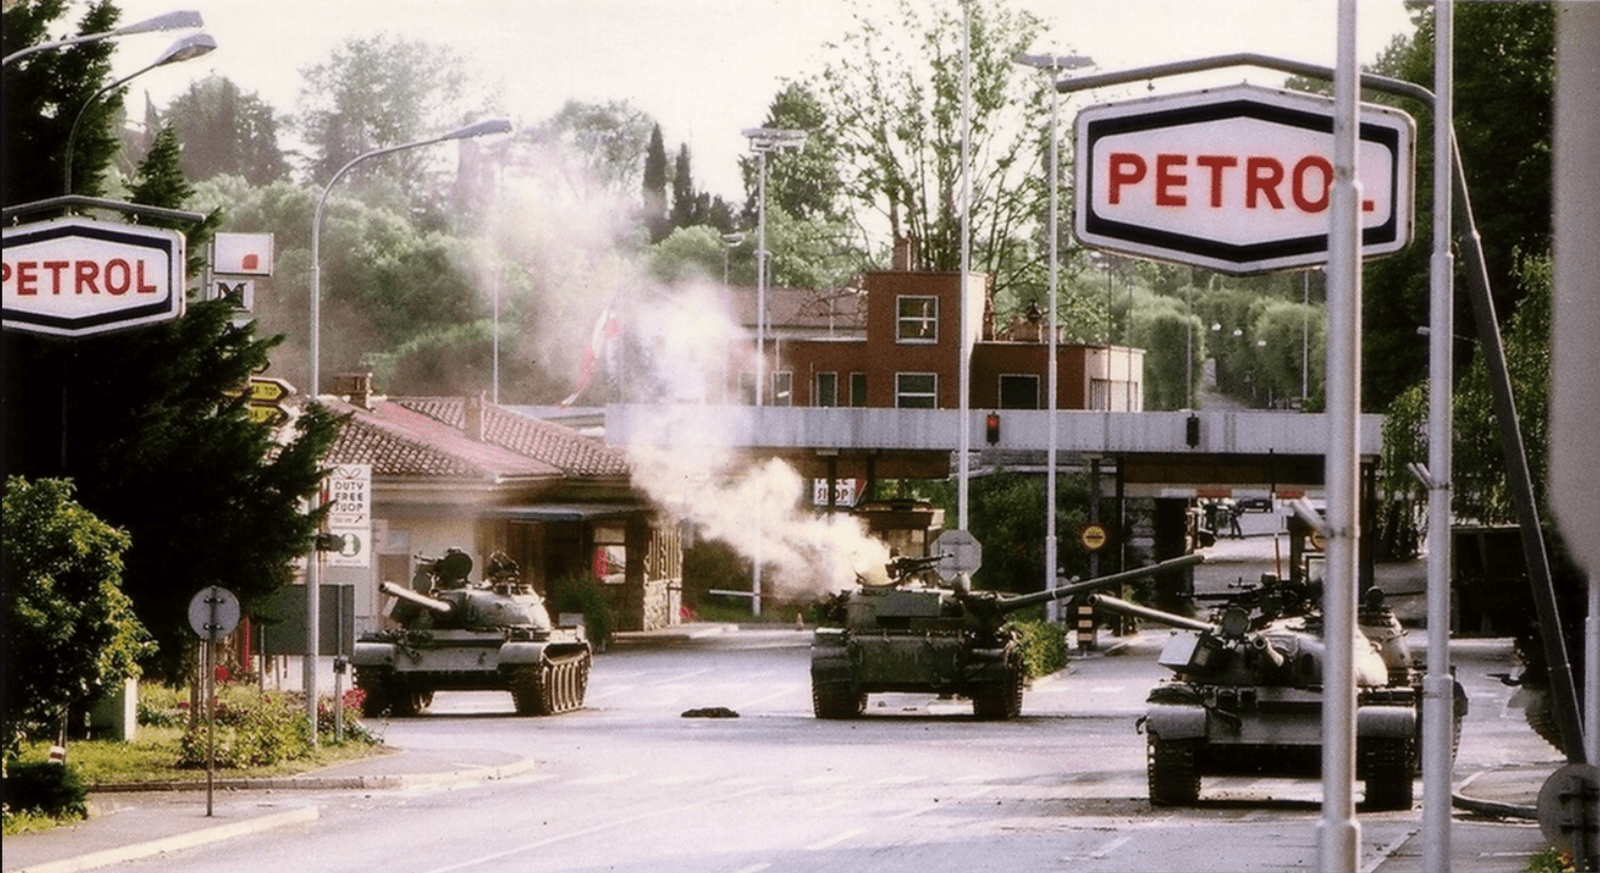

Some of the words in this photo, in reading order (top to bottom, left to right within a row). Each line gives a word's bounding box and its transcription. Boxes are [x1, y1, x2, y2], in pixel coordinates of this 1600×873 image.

[1108, 152, 1375, 214] PETRO
[335, 481, 364, 491] DUTY
[335, 492, 364, 502] FREE
